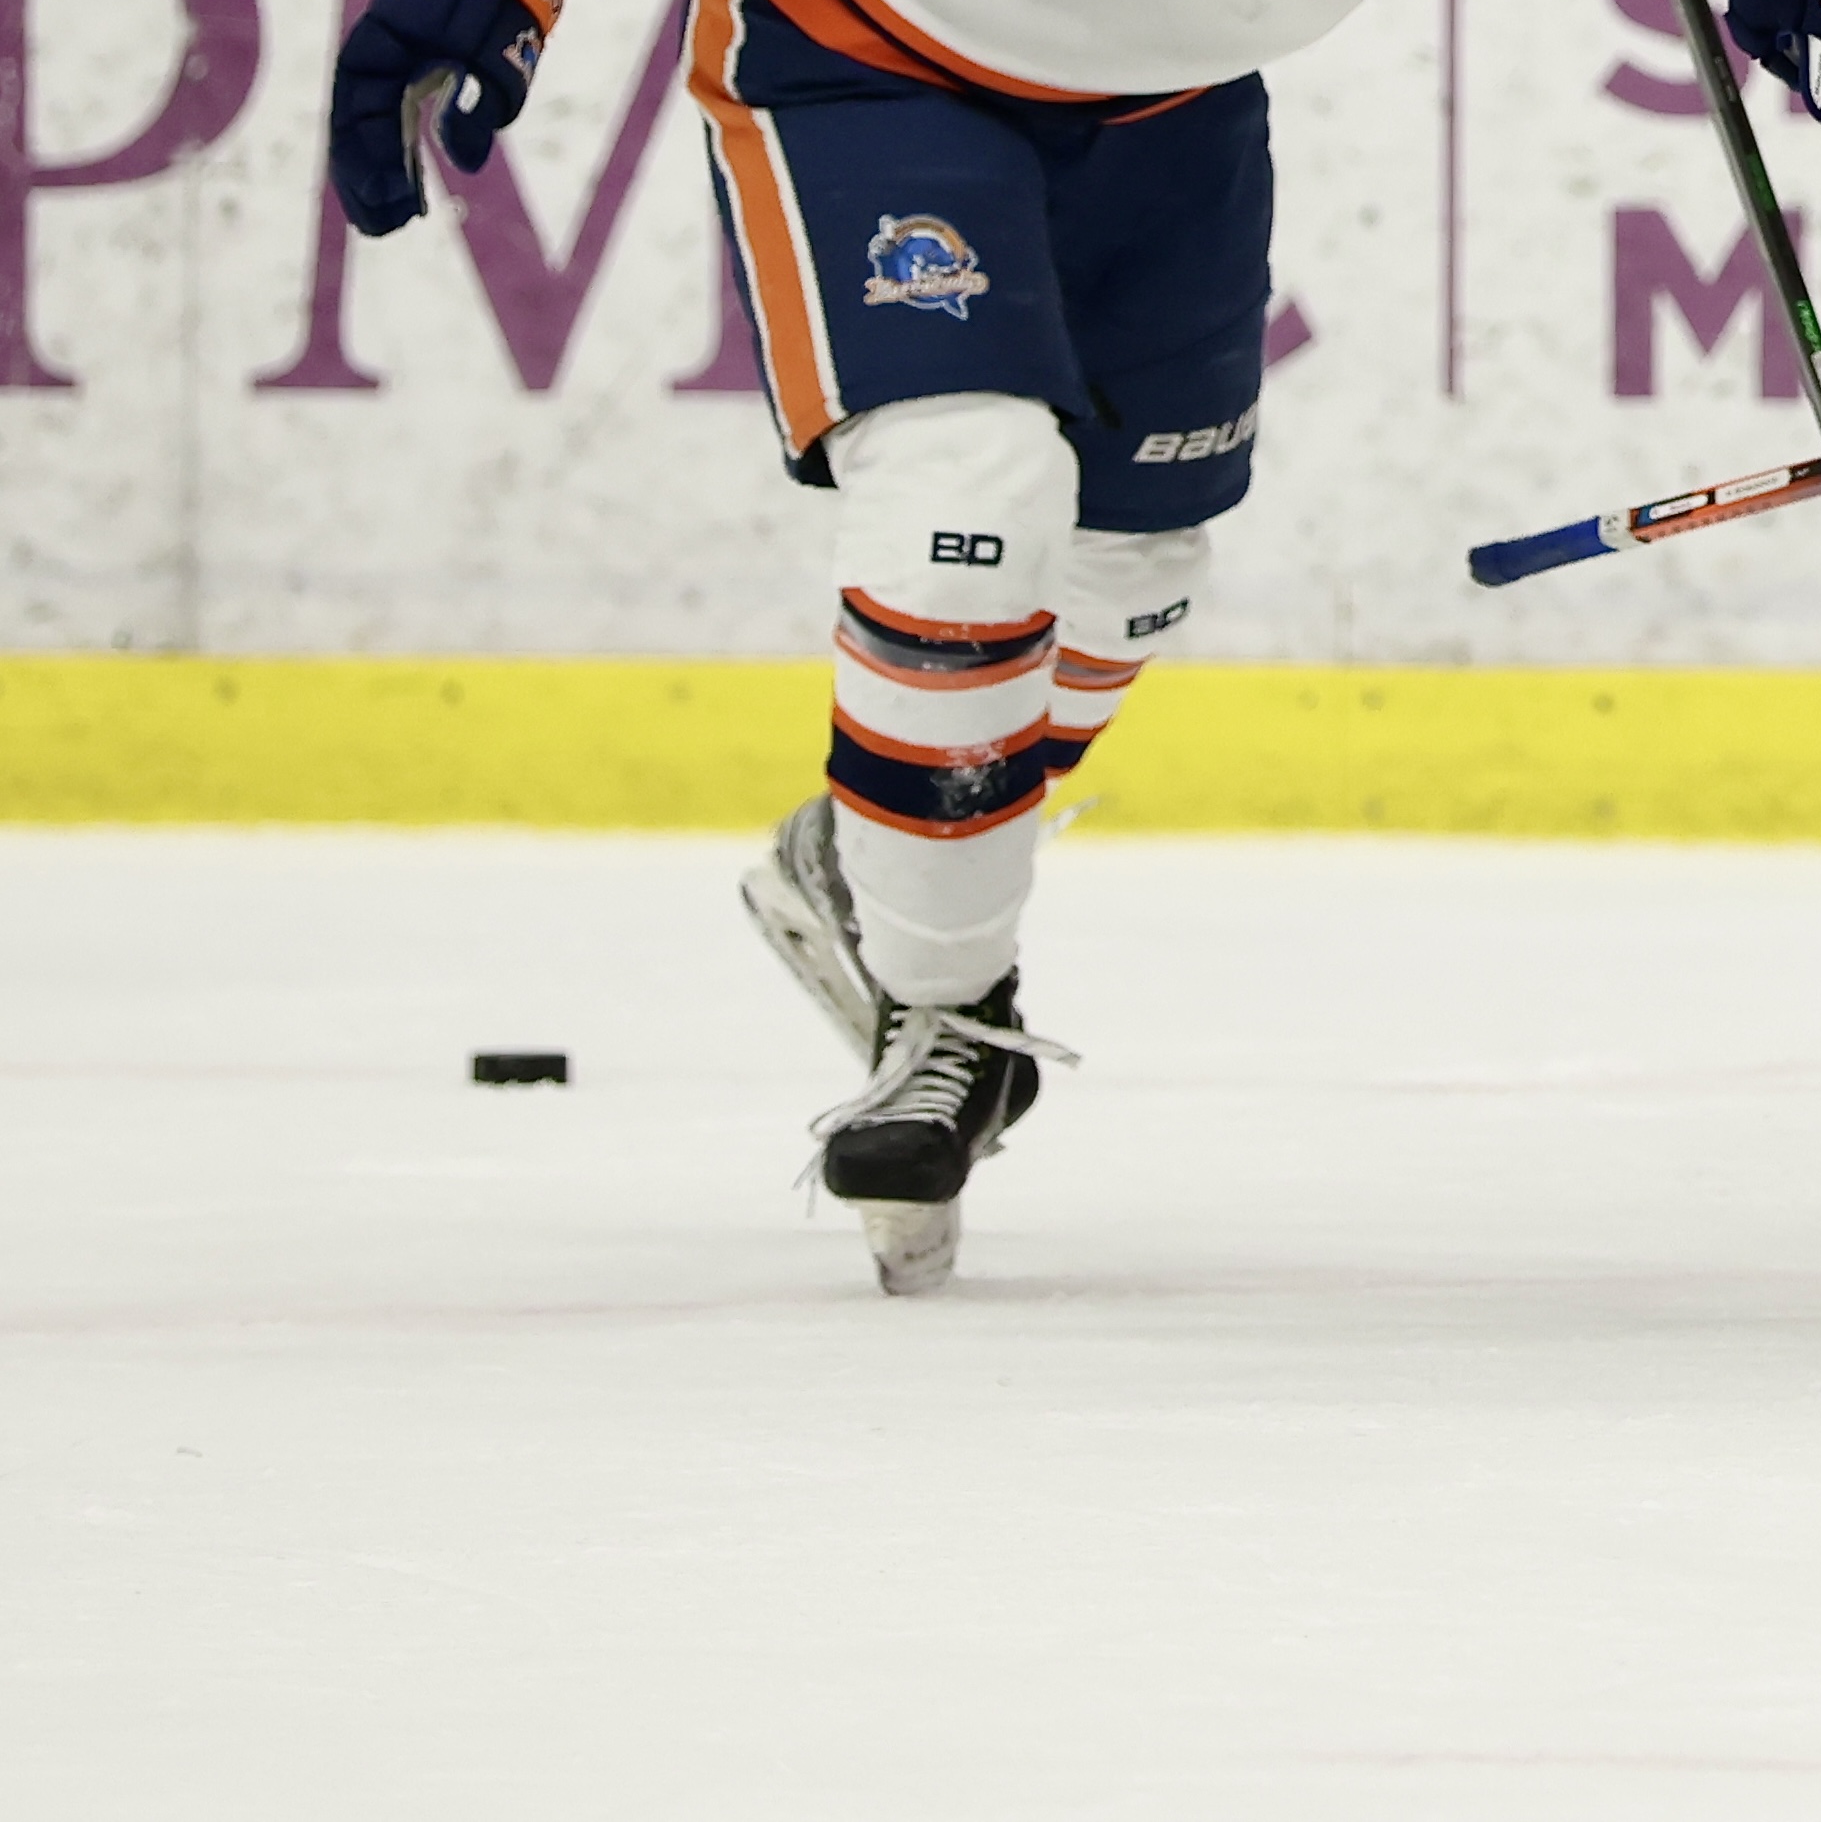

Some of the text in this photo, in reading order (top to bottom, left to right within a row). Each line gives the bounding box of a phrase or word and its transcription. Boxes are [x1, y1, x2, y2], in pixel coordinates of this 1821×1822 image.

[1131, 402, 1263, 464] BAU
[930, 530, 1003, 567] BD
[1126, 598, 1189, 640] BD
